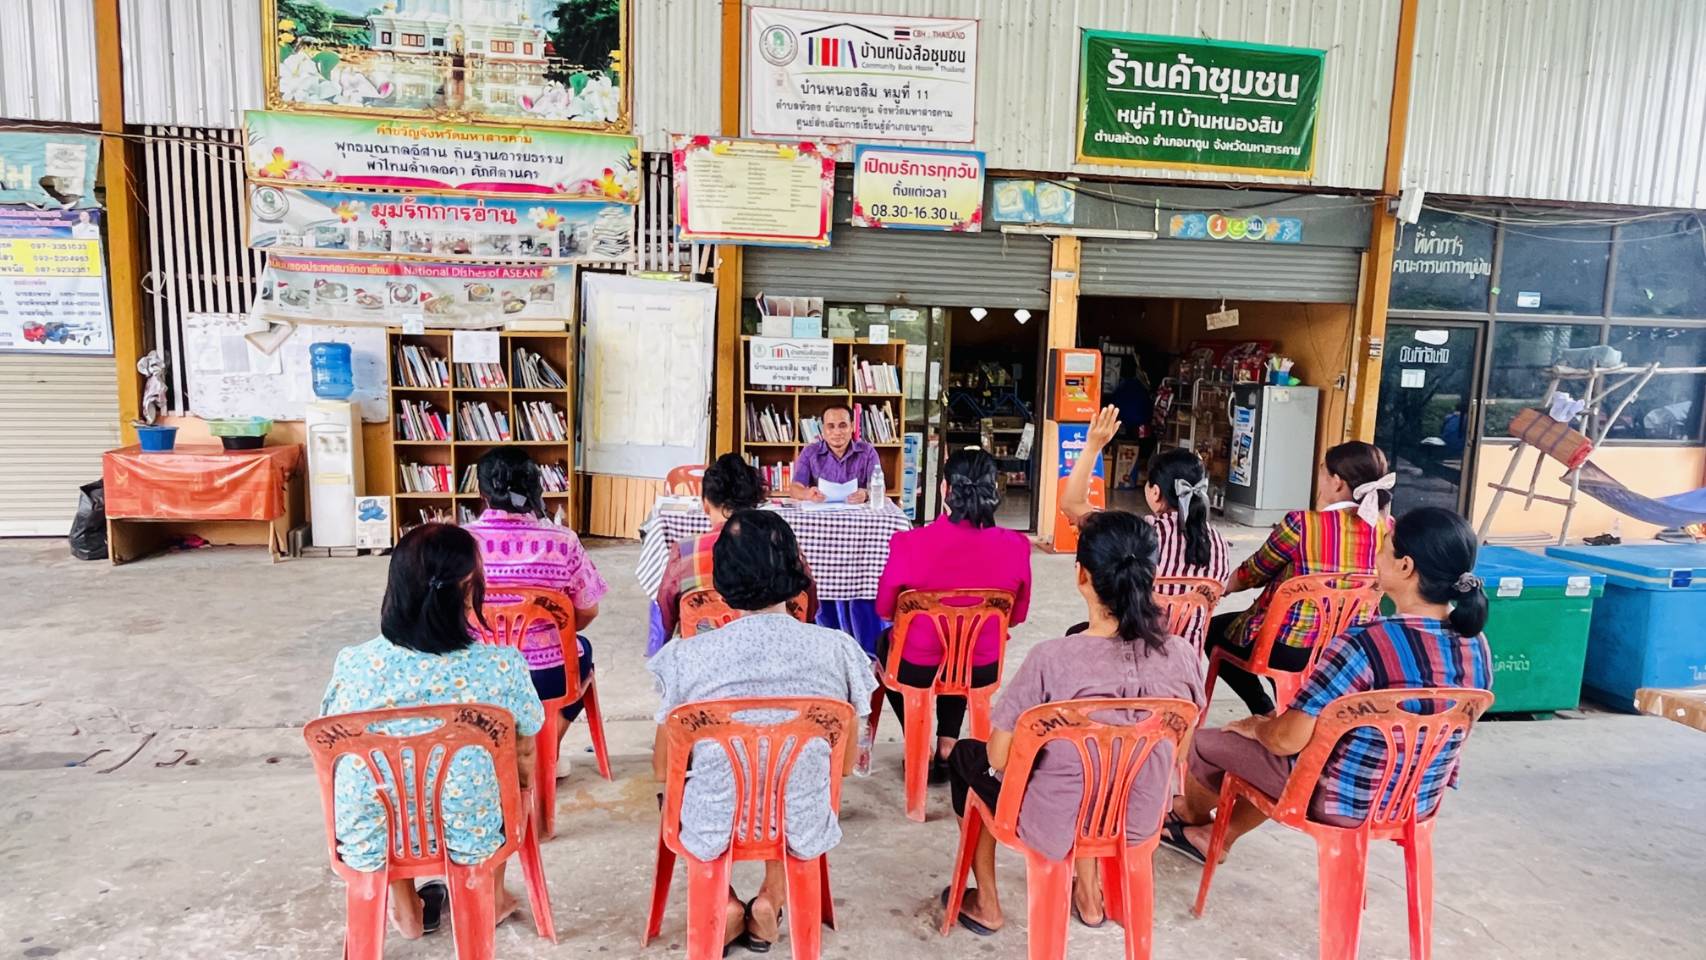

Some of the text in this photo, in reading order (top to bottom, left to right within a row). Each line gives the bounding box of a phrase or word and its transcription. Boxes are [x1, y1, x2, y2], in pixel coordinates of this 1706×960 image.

[932, 31, 966, 40] THAILAND
[861, 42, 966, 65] บ้านหนังสือชุมชน
[1106, 48, 1300, 104] ร้านค้าชุมชน
[801, 79, 929, 104] บ้านหนองสิม หมู่ที่ 11
[1117, 102, 1283, 134] หมู่ที่ 11 บ้านหนองสิม
[1094, 129, 1301, 156] ตำบลหัวดง อำเภอนาดูน จังหวัดมหาสารคาม
[864, 158, 977, 181] เปิดบริการทุกวัน
[892, 180, 947, 198] ตั้งแต่เวลา
[371, 196, 518, 229] มุมรักการอ่าน
[871, 204, 947, 219] 08.30-16.30
[404, 266, 449, 276] National
[451, 267, 487, 278] Dishes
[488, 268, 500, 278] of
[502, 269, 539, 278] ASEAN
[1393, 257, 1491, 280] คณะกรรมการหมู่บ้าน
[1336, 701, 1390, 721] SML
[1030, 713, 1080, 737] SML
